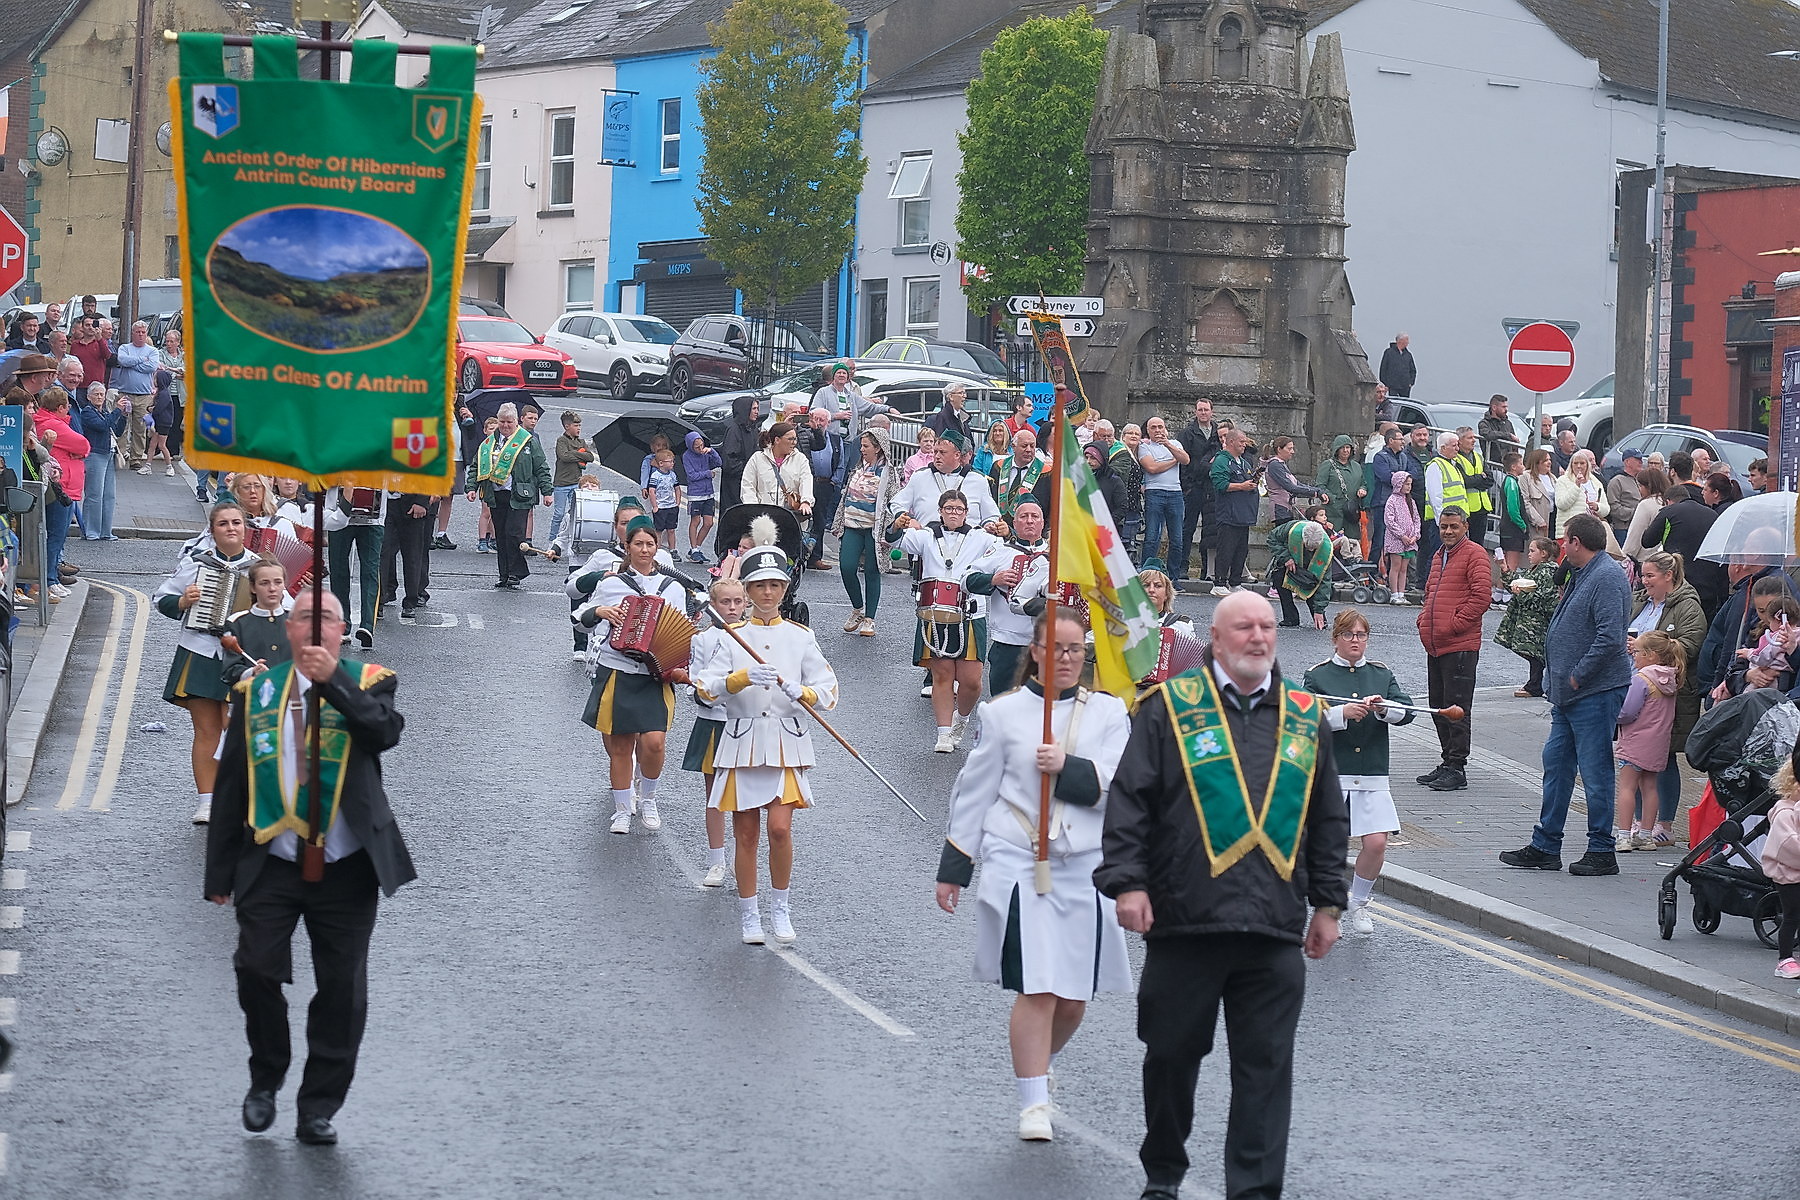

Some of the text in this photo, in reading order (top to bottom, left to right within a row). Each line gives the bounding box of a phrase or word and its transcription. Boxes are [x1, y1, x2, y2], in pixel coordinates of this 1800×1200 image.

[202, 150, 446, 179] Ancient Order Of Hibernians
[234, 168, 416, 194] Antrim County Board
[668, 263, 691, 275] M&P'S
[1021, 299, 1099, 312] C'bayney 10
[1021, 322, 1081, 332] A 8
[202, 359, 428, 394] Green Glens Of Antrim
[1031, 393, 1055, 404] M&
